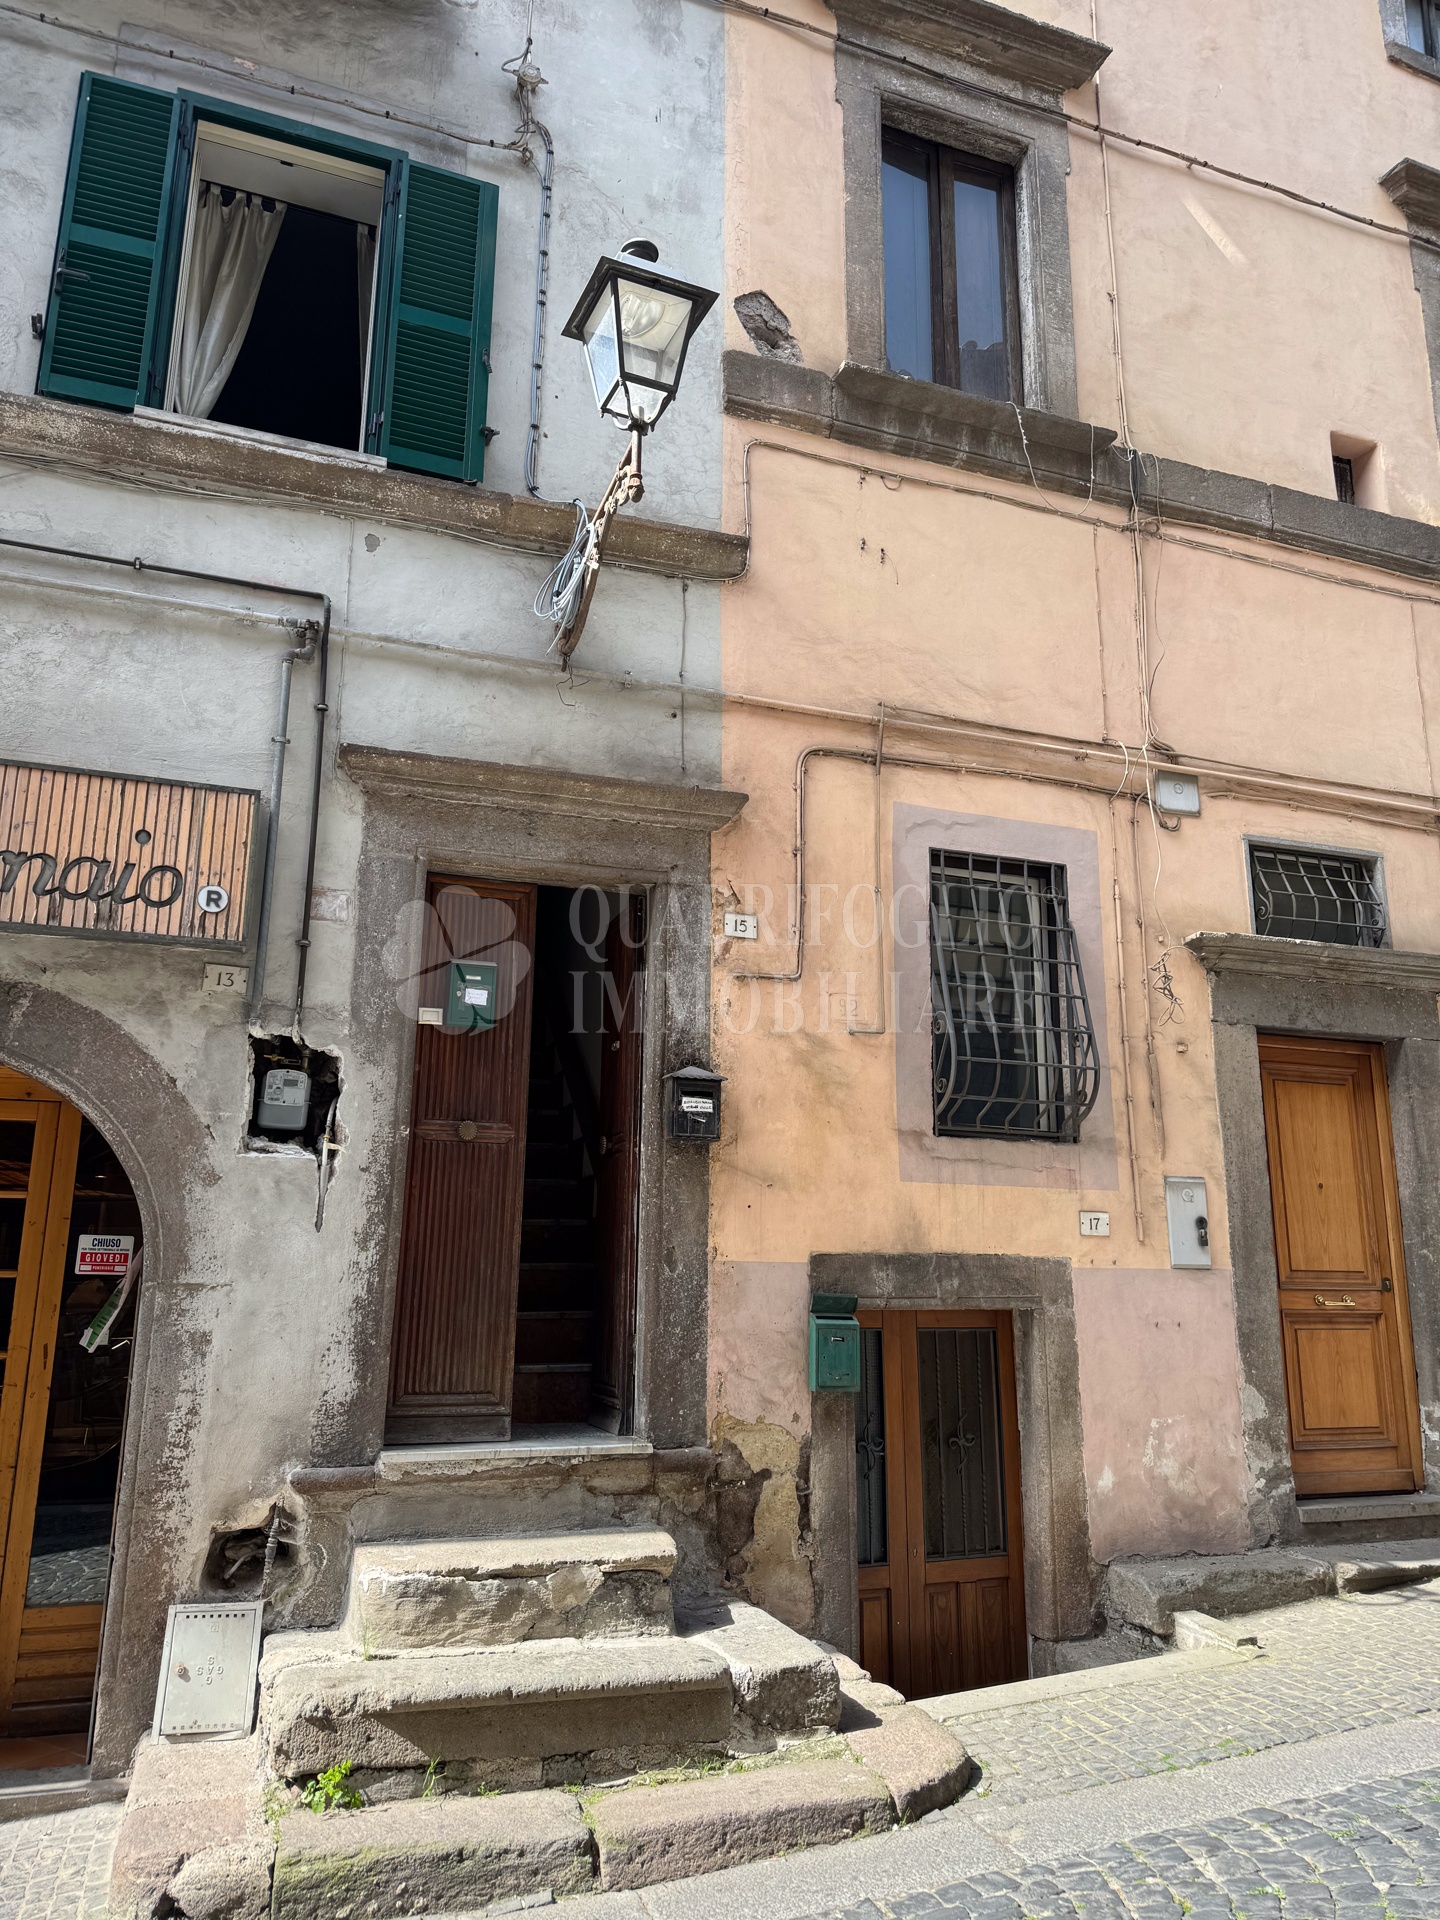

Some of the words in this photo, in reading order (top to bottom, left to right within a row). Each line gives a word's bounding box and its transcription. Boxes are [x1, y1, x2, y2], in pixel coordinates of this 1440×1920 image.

[734, 918, 748, 933] 15
[216, 971, 235, 988] 13
[1089, 1217, 1100, 1231] 17
[92, 1237, 121, 1248] CHIUSO
[85, 1253, 124, 1263] GIOVEDI
